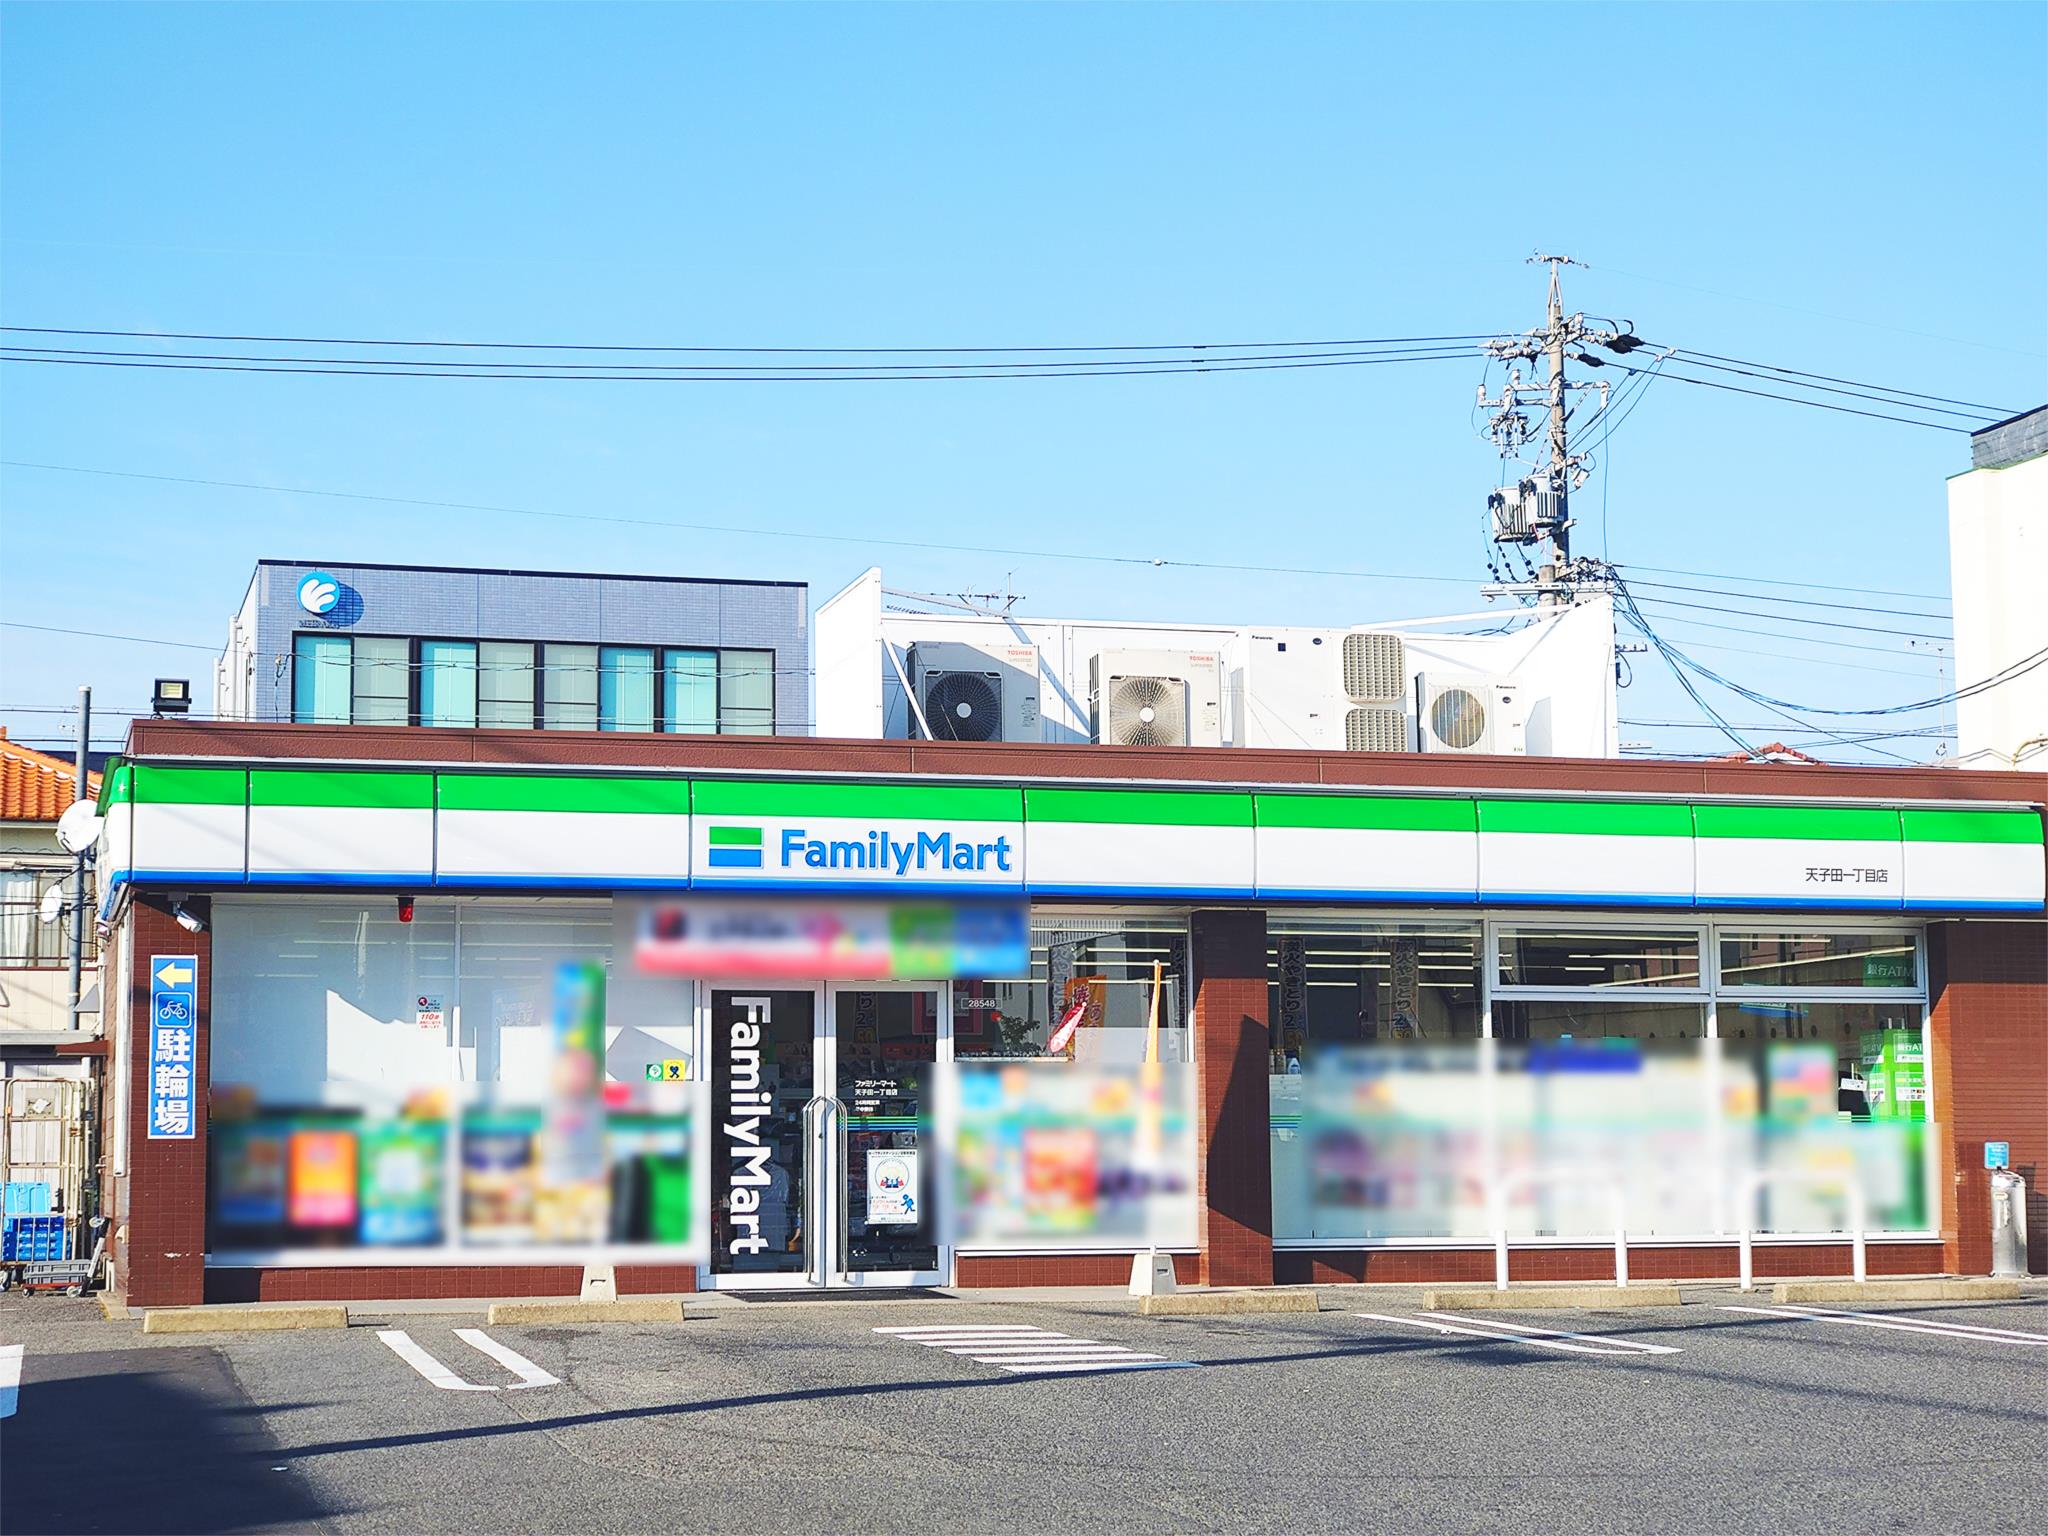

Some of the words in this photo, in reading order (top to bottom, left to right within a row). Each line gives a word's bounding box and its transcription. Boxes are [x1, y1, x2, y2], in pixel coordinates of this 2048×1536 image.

[781, 829, 1011, 876] FamilyMart
[1805, 868, 1888, 883] 天子田一丁目店
[968, 1000, 996, 1008] 28548
[154, 1029, 191, 1135] 駐輪場
[855, 1080, 897, 1088] ファミリーマート
[723, 997, 772, 1255] FamilyMart
